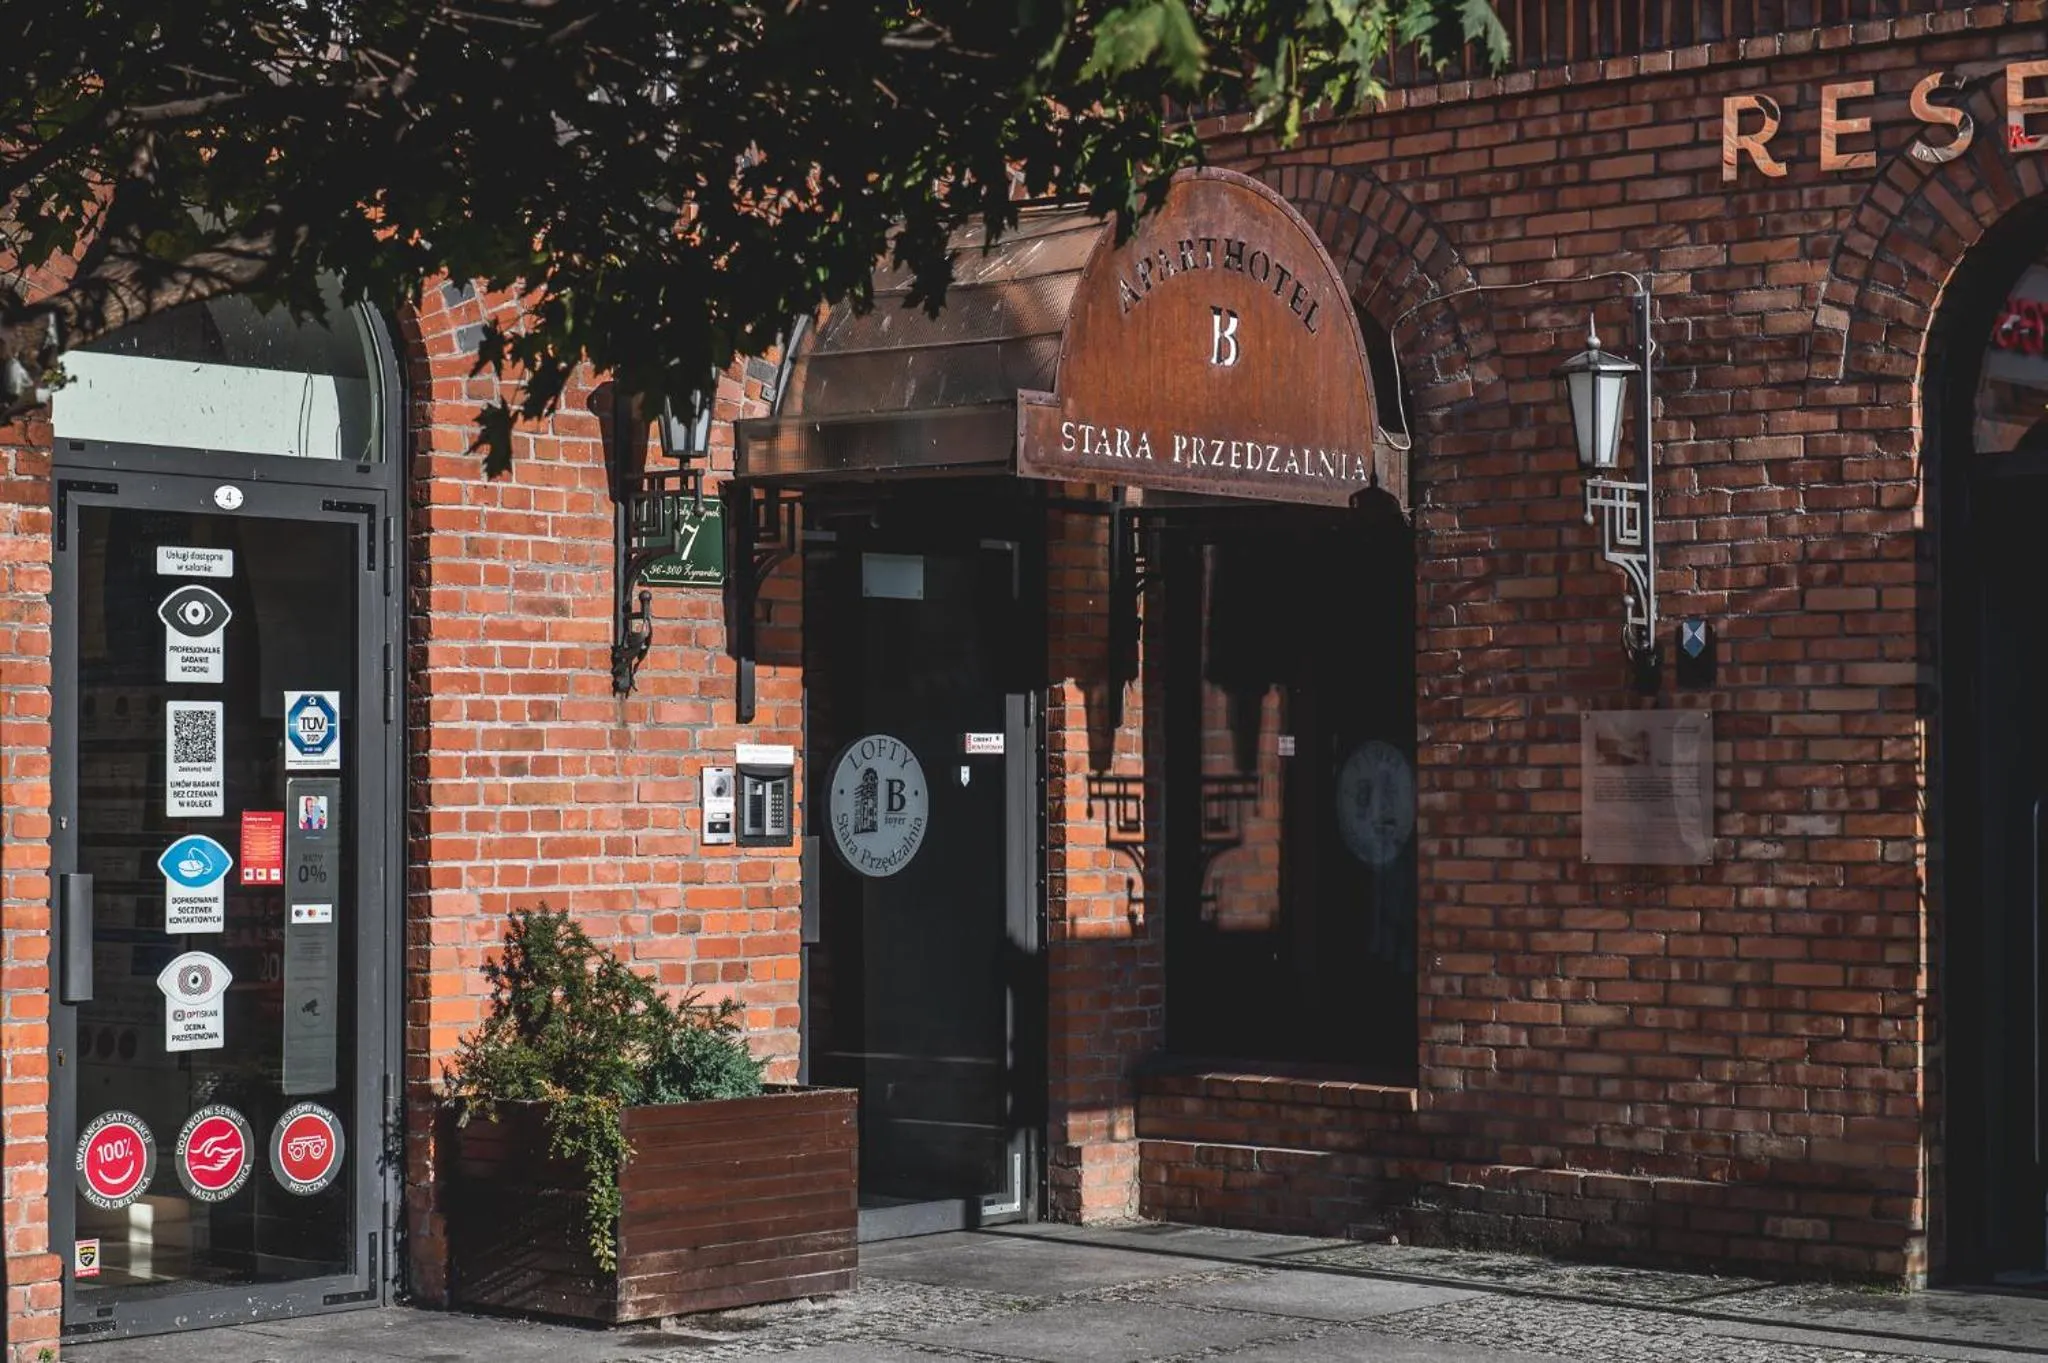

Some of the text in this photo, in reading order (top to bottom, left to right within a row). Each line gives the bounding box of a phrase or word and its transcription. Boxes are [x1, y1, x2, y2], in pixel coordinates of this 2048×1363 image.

[1119, 236, 1322, 336] APARTHOTEL
[1209, 305, 1240, 368] B
[1061, 421, 1368, 482] STARA PRZEDZALNIA
[225, 491, 232, 504] 4
[680, 521, 700, 561] 7
[166, 550, 224, 563] Usługi dostępne
[169, 645, 221, 655] PROFESJONALNE
[181, 655, 209, 664] BADANIE
[299, 716, 326, 731] TÜV
[847, 737, 914, 771] LOFTY
[170, 779, 192, 789] UMÓW
[173, 790, 218, 799] BEZ CZEKANIA
[178, 800, 213, 808] W KOLEJCE
[885, 778, 906, 812] B
[836, 812, 924, 872] Stara Przędzalnia
[298, 864, 327, 884] 0%
[171, 896, 219, 904] DOPASOWANIE
[178, 906, 213, 914] SOCZEWEK
[169, 915, 222, 925] KONTAKTOWYCH
[184, 1023, 207, 1032] OCENA
[214, 1106, 245, 1126] SERWIS
[280, 1104, 312, 1128] JESTEŚMY
[76, 1112, 152, 1171] GWARANCJA SATYSFAKCJI
[96, 1136, 133, 1164] 100%
[84, 1176, 151, 1209] NASZA OBIETNICA
[190, 1164, 252, 1201] NASZA OBIETNICA
